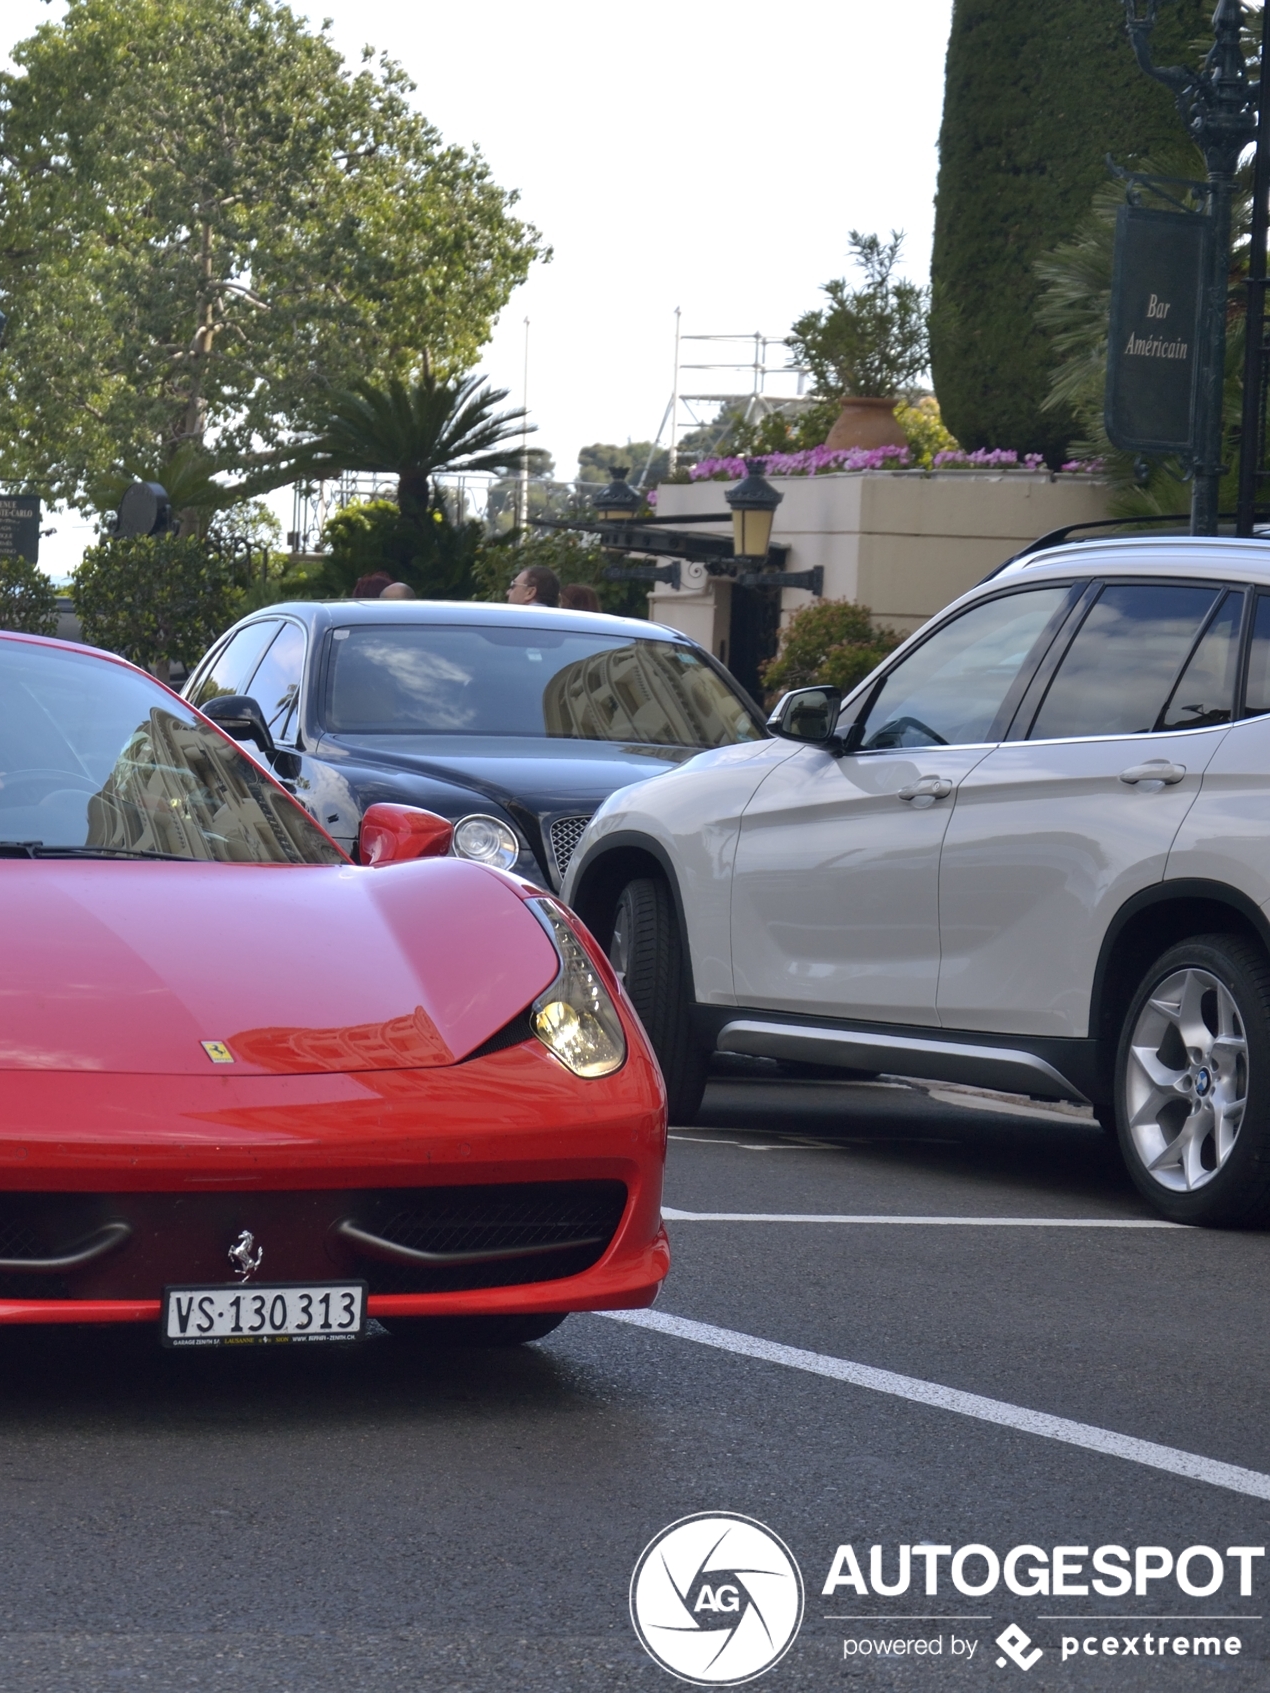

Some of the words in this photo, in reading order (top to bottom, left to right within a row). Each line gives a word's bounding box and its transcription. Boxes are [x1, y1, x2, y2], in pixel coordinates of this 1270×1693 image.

[1147, 294, 1170, 319] Bar
[1124, 331, 1188, 360] Américain
[196, 1338, 213, 1346] ZENITH
[224, 1337, 255, 1345] LAUSANNE
